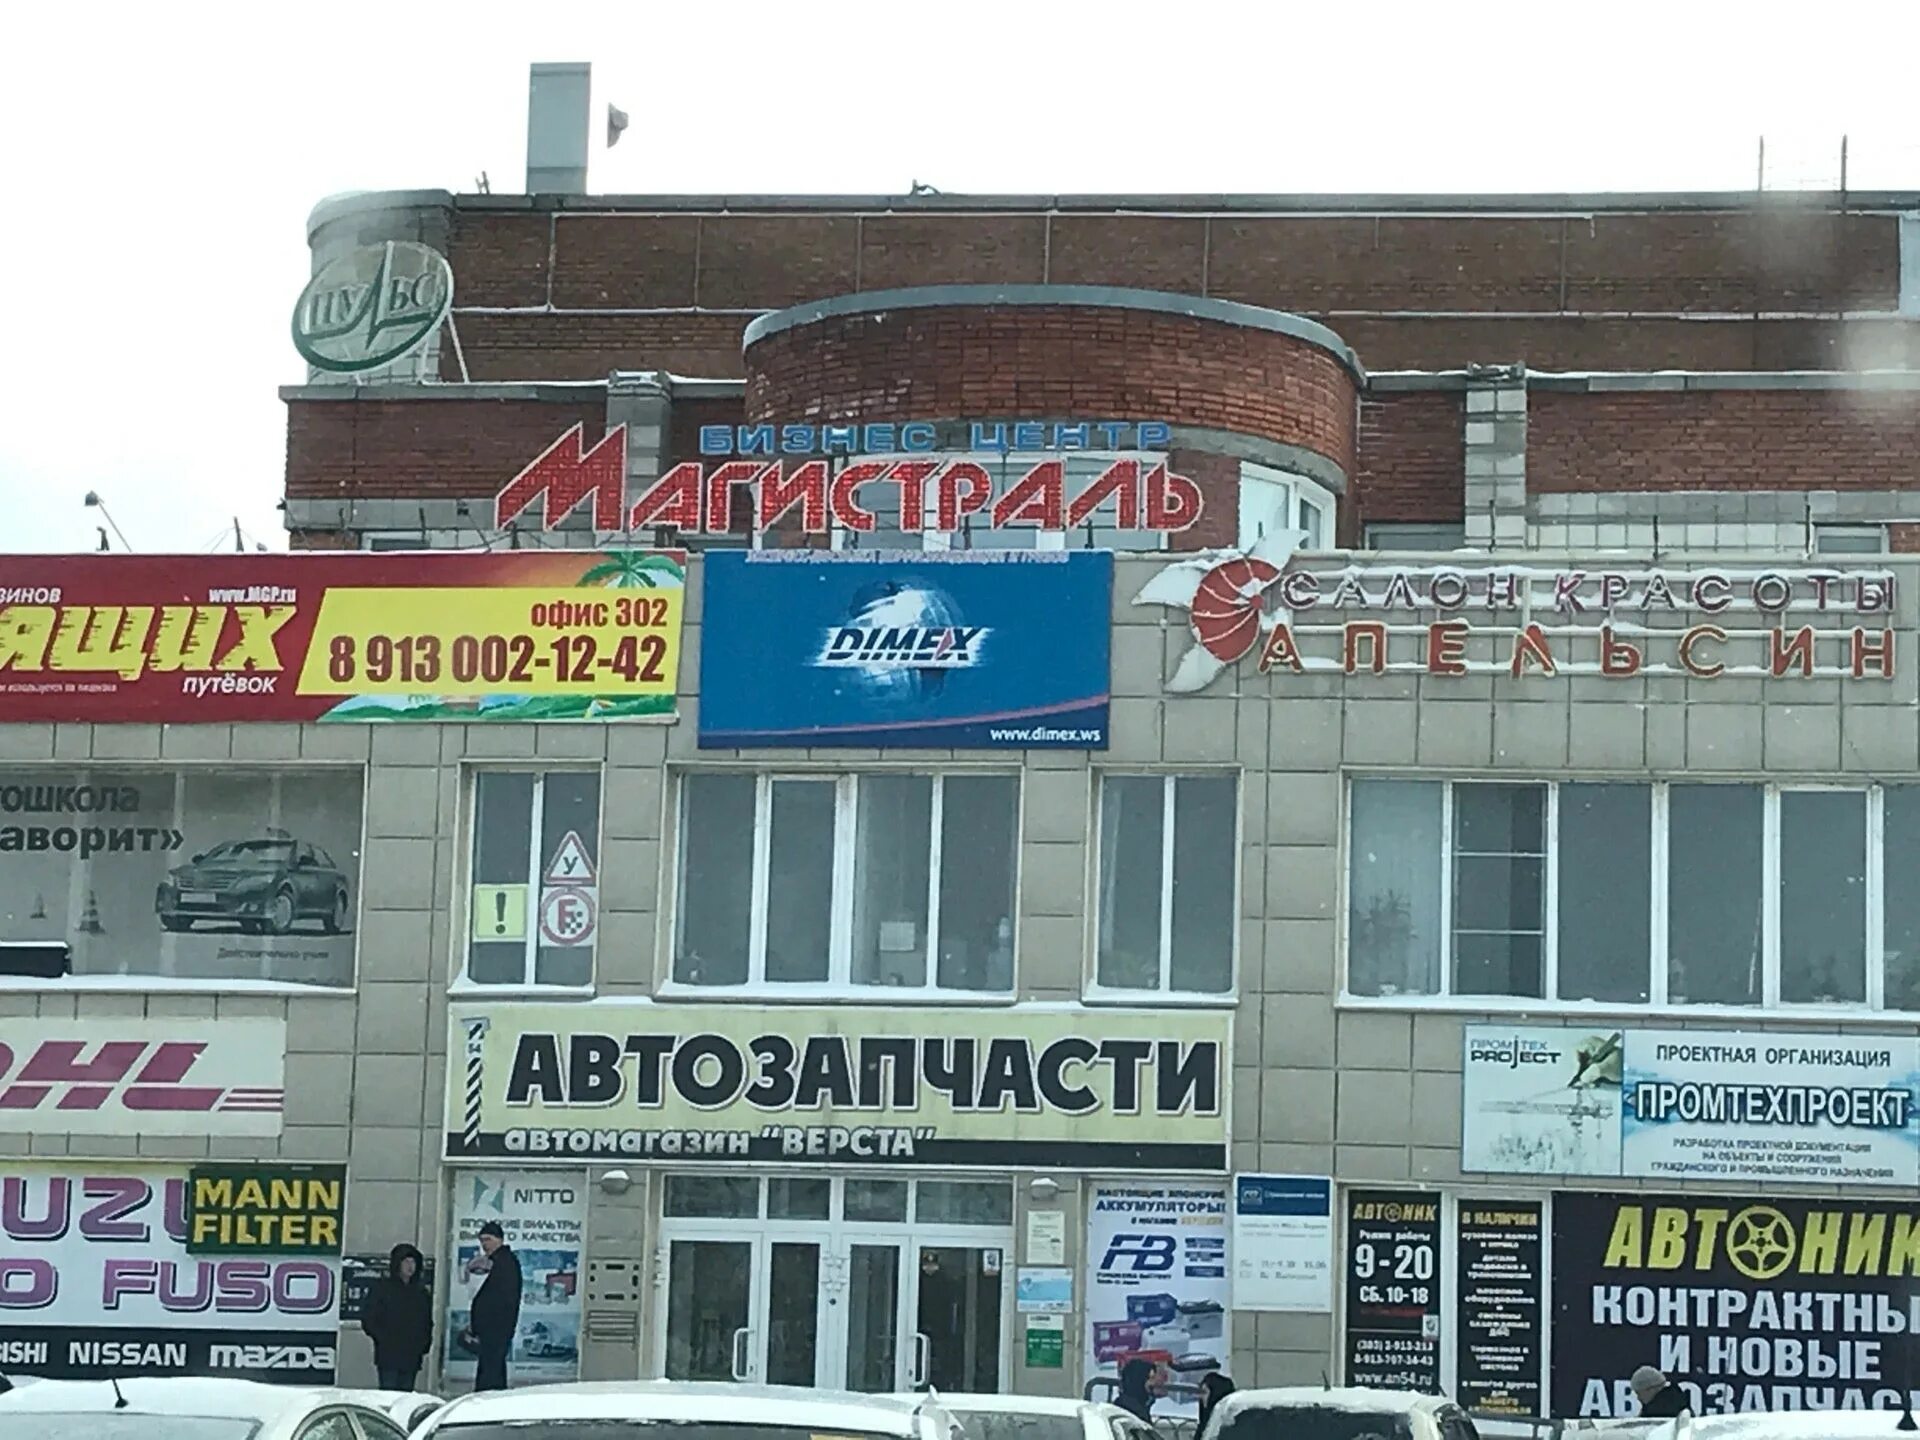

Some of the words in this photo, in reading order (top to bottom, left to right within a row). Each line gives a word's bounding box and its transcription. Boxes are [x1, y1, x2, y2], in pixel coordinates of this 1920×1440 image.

[700, 423, 936, 455] БИЗНЕС
[970, 421, 1171, 451] ЦЕНТР
[1280, 571, 1518, 611] САЛОН
[1555, 573, 1895, 614] КРАСОТЫ
[531, 600, 608, 630] офис
[615, 598, 669, 628] 302
[329, 635, 356, 683] 8
[366, 635, 441, 683] 913
[452, 634, 668, 683] 002-12-42
[827, 627, 985, 661] DIMEX
[1256, 620, 1895, 679] АПЕЛЬСИН
[182, 672, 278, 697] путёвок
[990, 727, 1102, 742] www.dimex.ws
[0, 785, 140, 812] ошкола
[1657, 1044, 1757, 1063] ПРОЕКТНАЯ
[1765, 1048, 1891, 1068] ОРГАНИЗАЦИЯ
[0, 1041, 223, 1111] HL
[504, 1032, 1222, 1116] АВТОЗАПЧАСТИ
[1636, 1083, 1910, 1128] ПРОМТЕХПРОЕКТ
[504, 1128, 750, 1155] автомагазин
[195, 1178, 340, 1210] MANN
[513, 1189, 576, 1204] NITTO
[193, 1213, 338, 1246] FILTER
[1100, 1233, 1177, 1271] FB
[103, 1259, 335, 1313] FUSO
[0, 1341, 48, 1364] ISHI
[68, 1342, 188, 1367] NISSAN
[1660, 1334, 1691, 1374] И
[1708, 1335, 1882, 1381] НОВЫЕ
